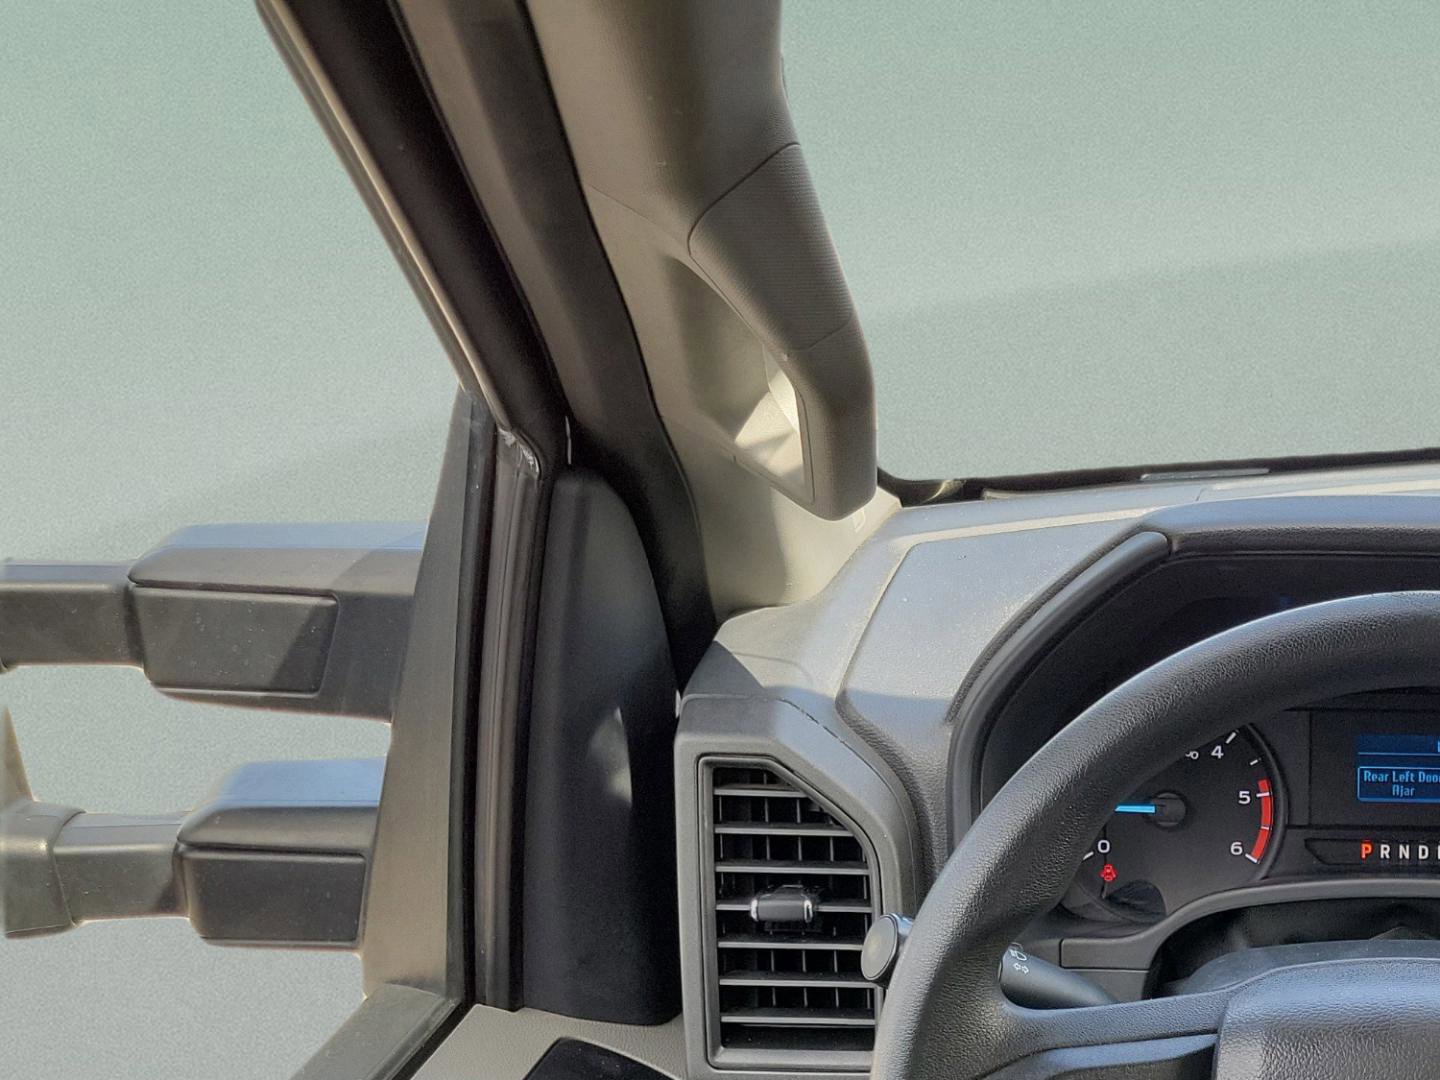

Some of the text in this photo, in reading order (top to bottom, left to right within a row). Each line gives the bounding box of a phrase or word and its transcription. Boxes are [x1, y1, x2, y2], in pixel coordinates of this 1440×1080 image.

[1211, 746, 1224, 759] 4
[1363, 770, 1389, 782] Rear
[1392, 771, 1415, 783] Left
[1238, 790, 1250, 805] 5
[1392, 785, 1415, 797] Ajar
[1097, 839, 1111, 853] 0
[1230, 841, 1243, 855] 6
[1360, 843, 1373, 858] P
[1380, 843, 1390, 859] R
[1399, 844, 1410, 860] N
[1418, 844, 1429, 860] D
